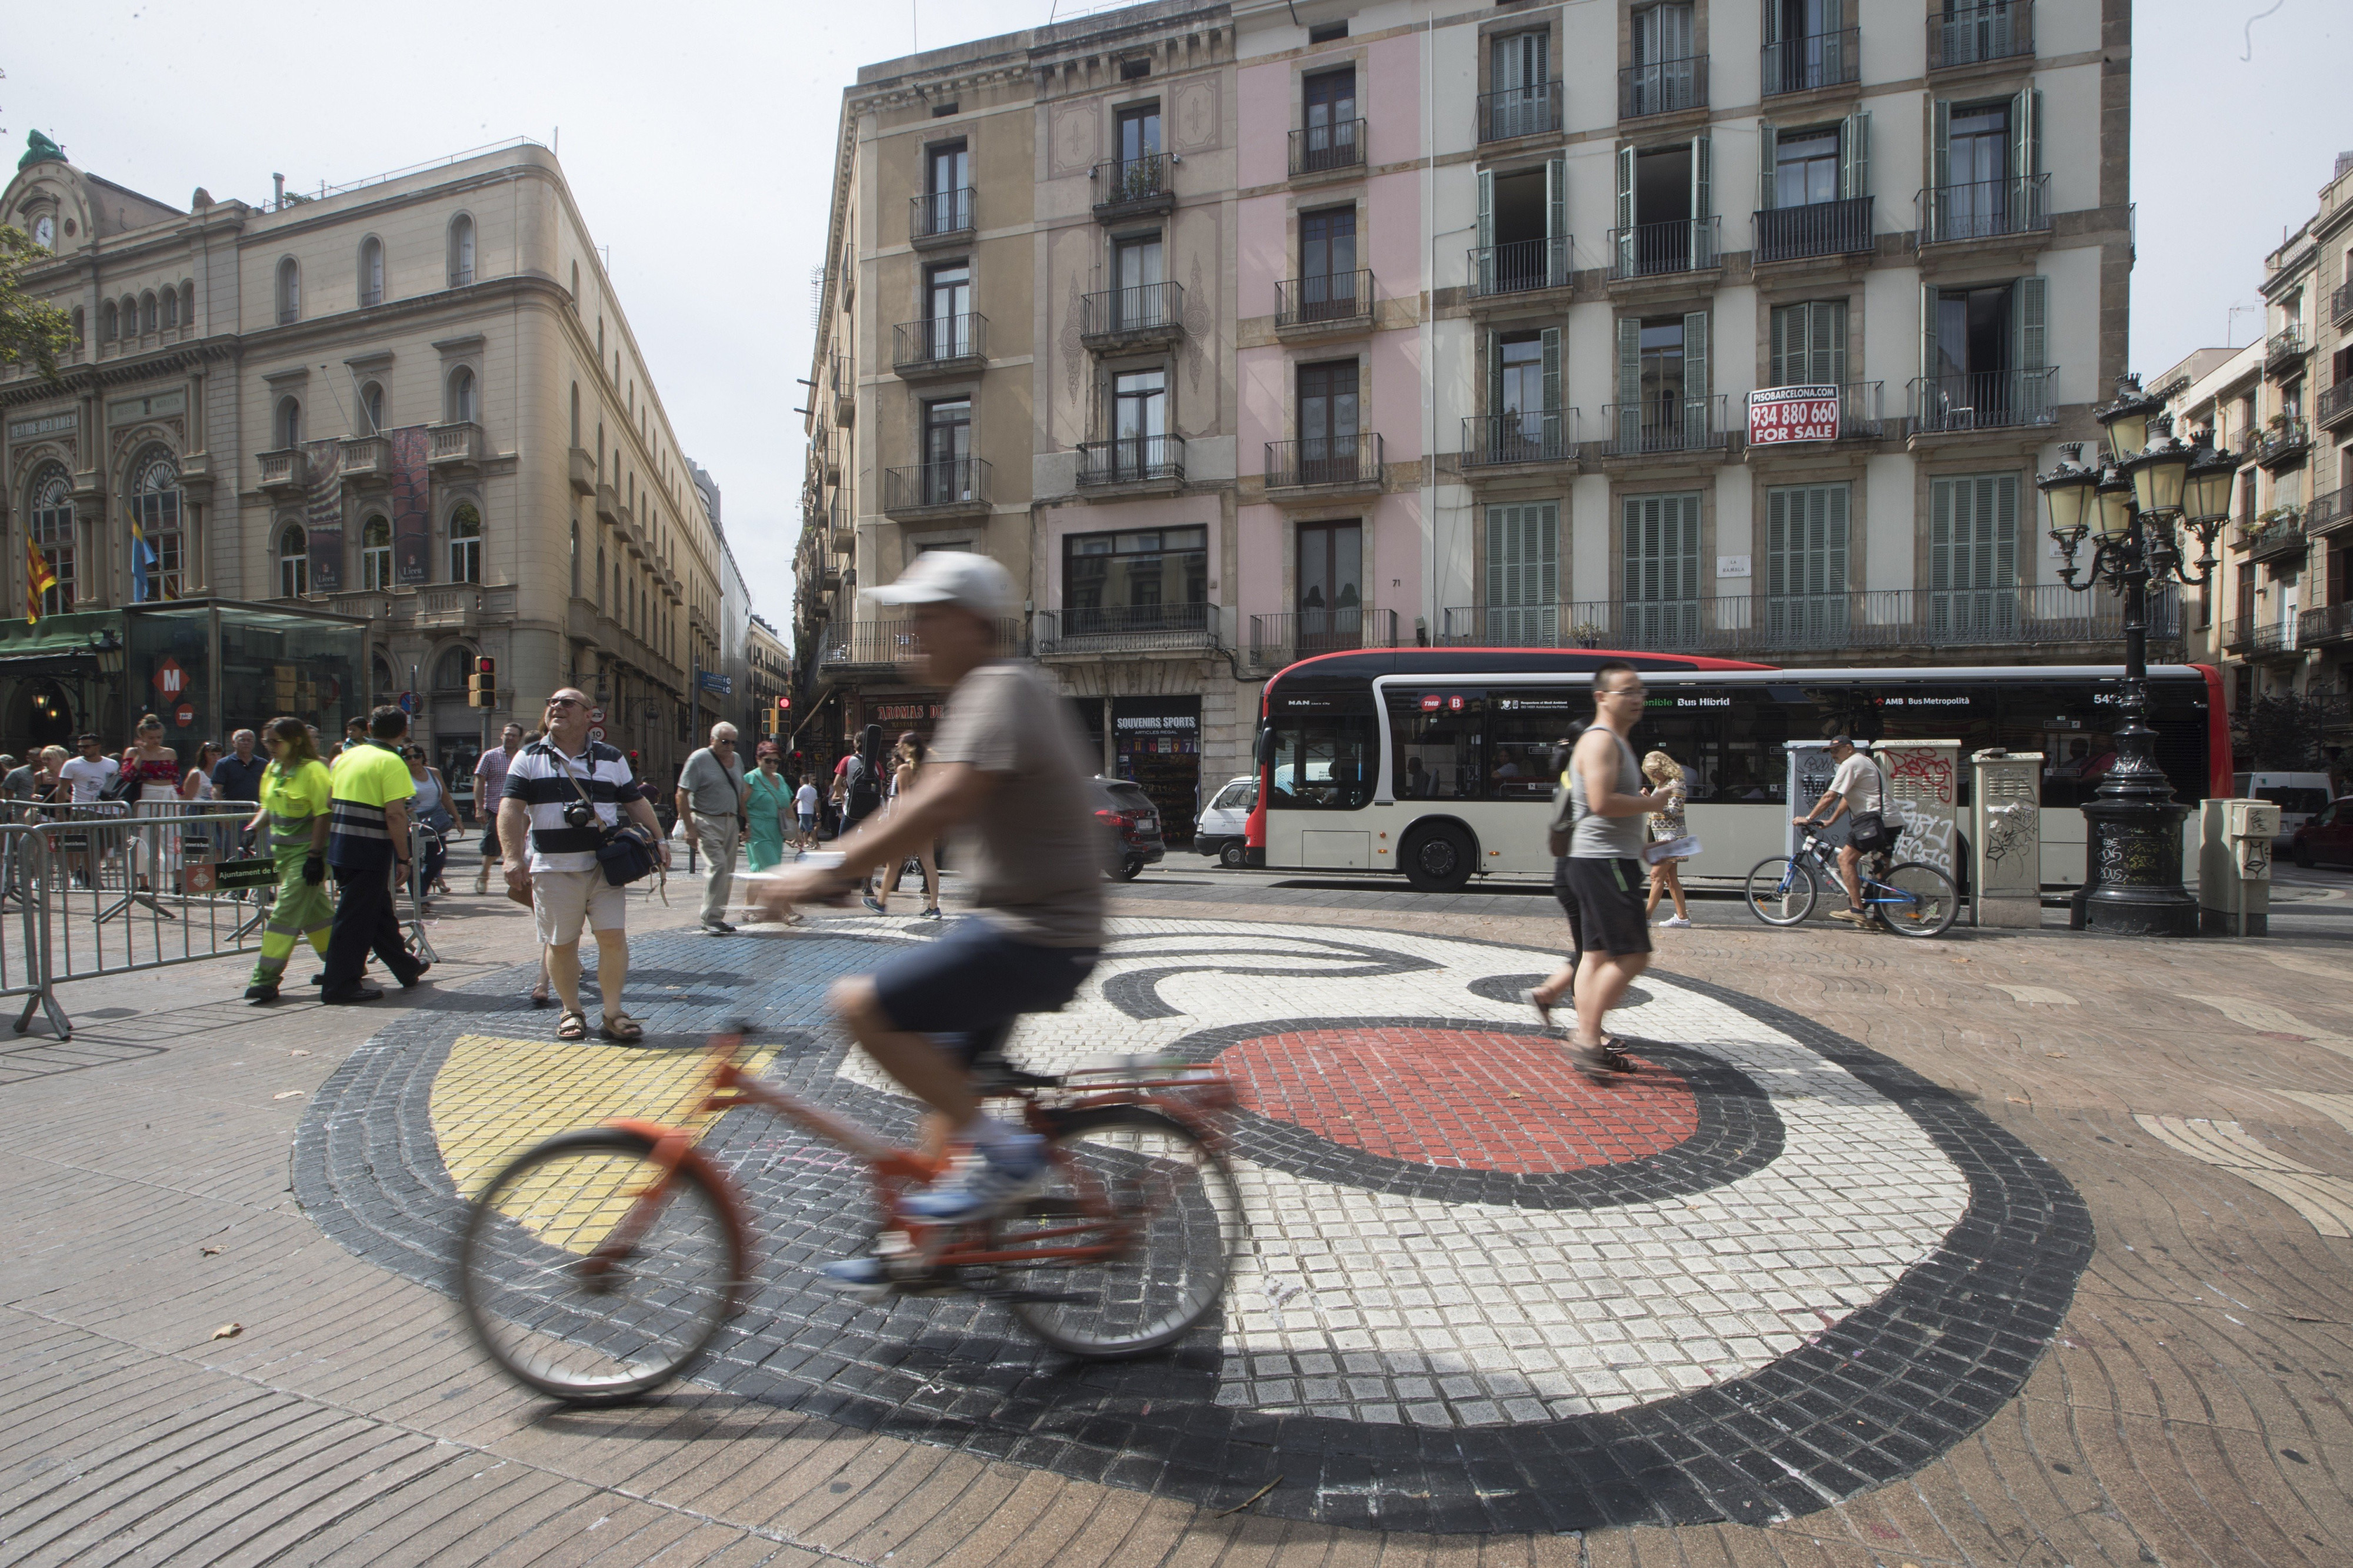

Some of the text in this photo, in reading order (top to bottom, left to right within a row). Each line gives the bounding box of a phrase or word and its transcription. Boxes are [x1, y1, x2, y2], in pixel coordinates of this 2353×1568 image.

[1753, 388, 1834, 403] PISOBARCELONA.COM
[1752, 401, 1837, 428] 934 880 660
[11, 421, 39, 438] TEATRE
[39, 419, 55, 433] DEL
[1755, 425, 1832, 442] FOR SALE
[164, 669, 179, 691] M
[1699, 698, 1729, 706] Híbrid
[1923, 697, 1969, 705] Metropolità
[877, 705, 924, 720] AROMAS
[929, 705, 944, 718] DE
[1117, 716, 1195, 729] SOUVENIRS SPORTS
[1149, 743, 1157, 752] 10
[1174, 743, 1179, 752] 9
[1185, 743, 1191, 753] 7
[219, 869, 260, 879] Ajuntament
